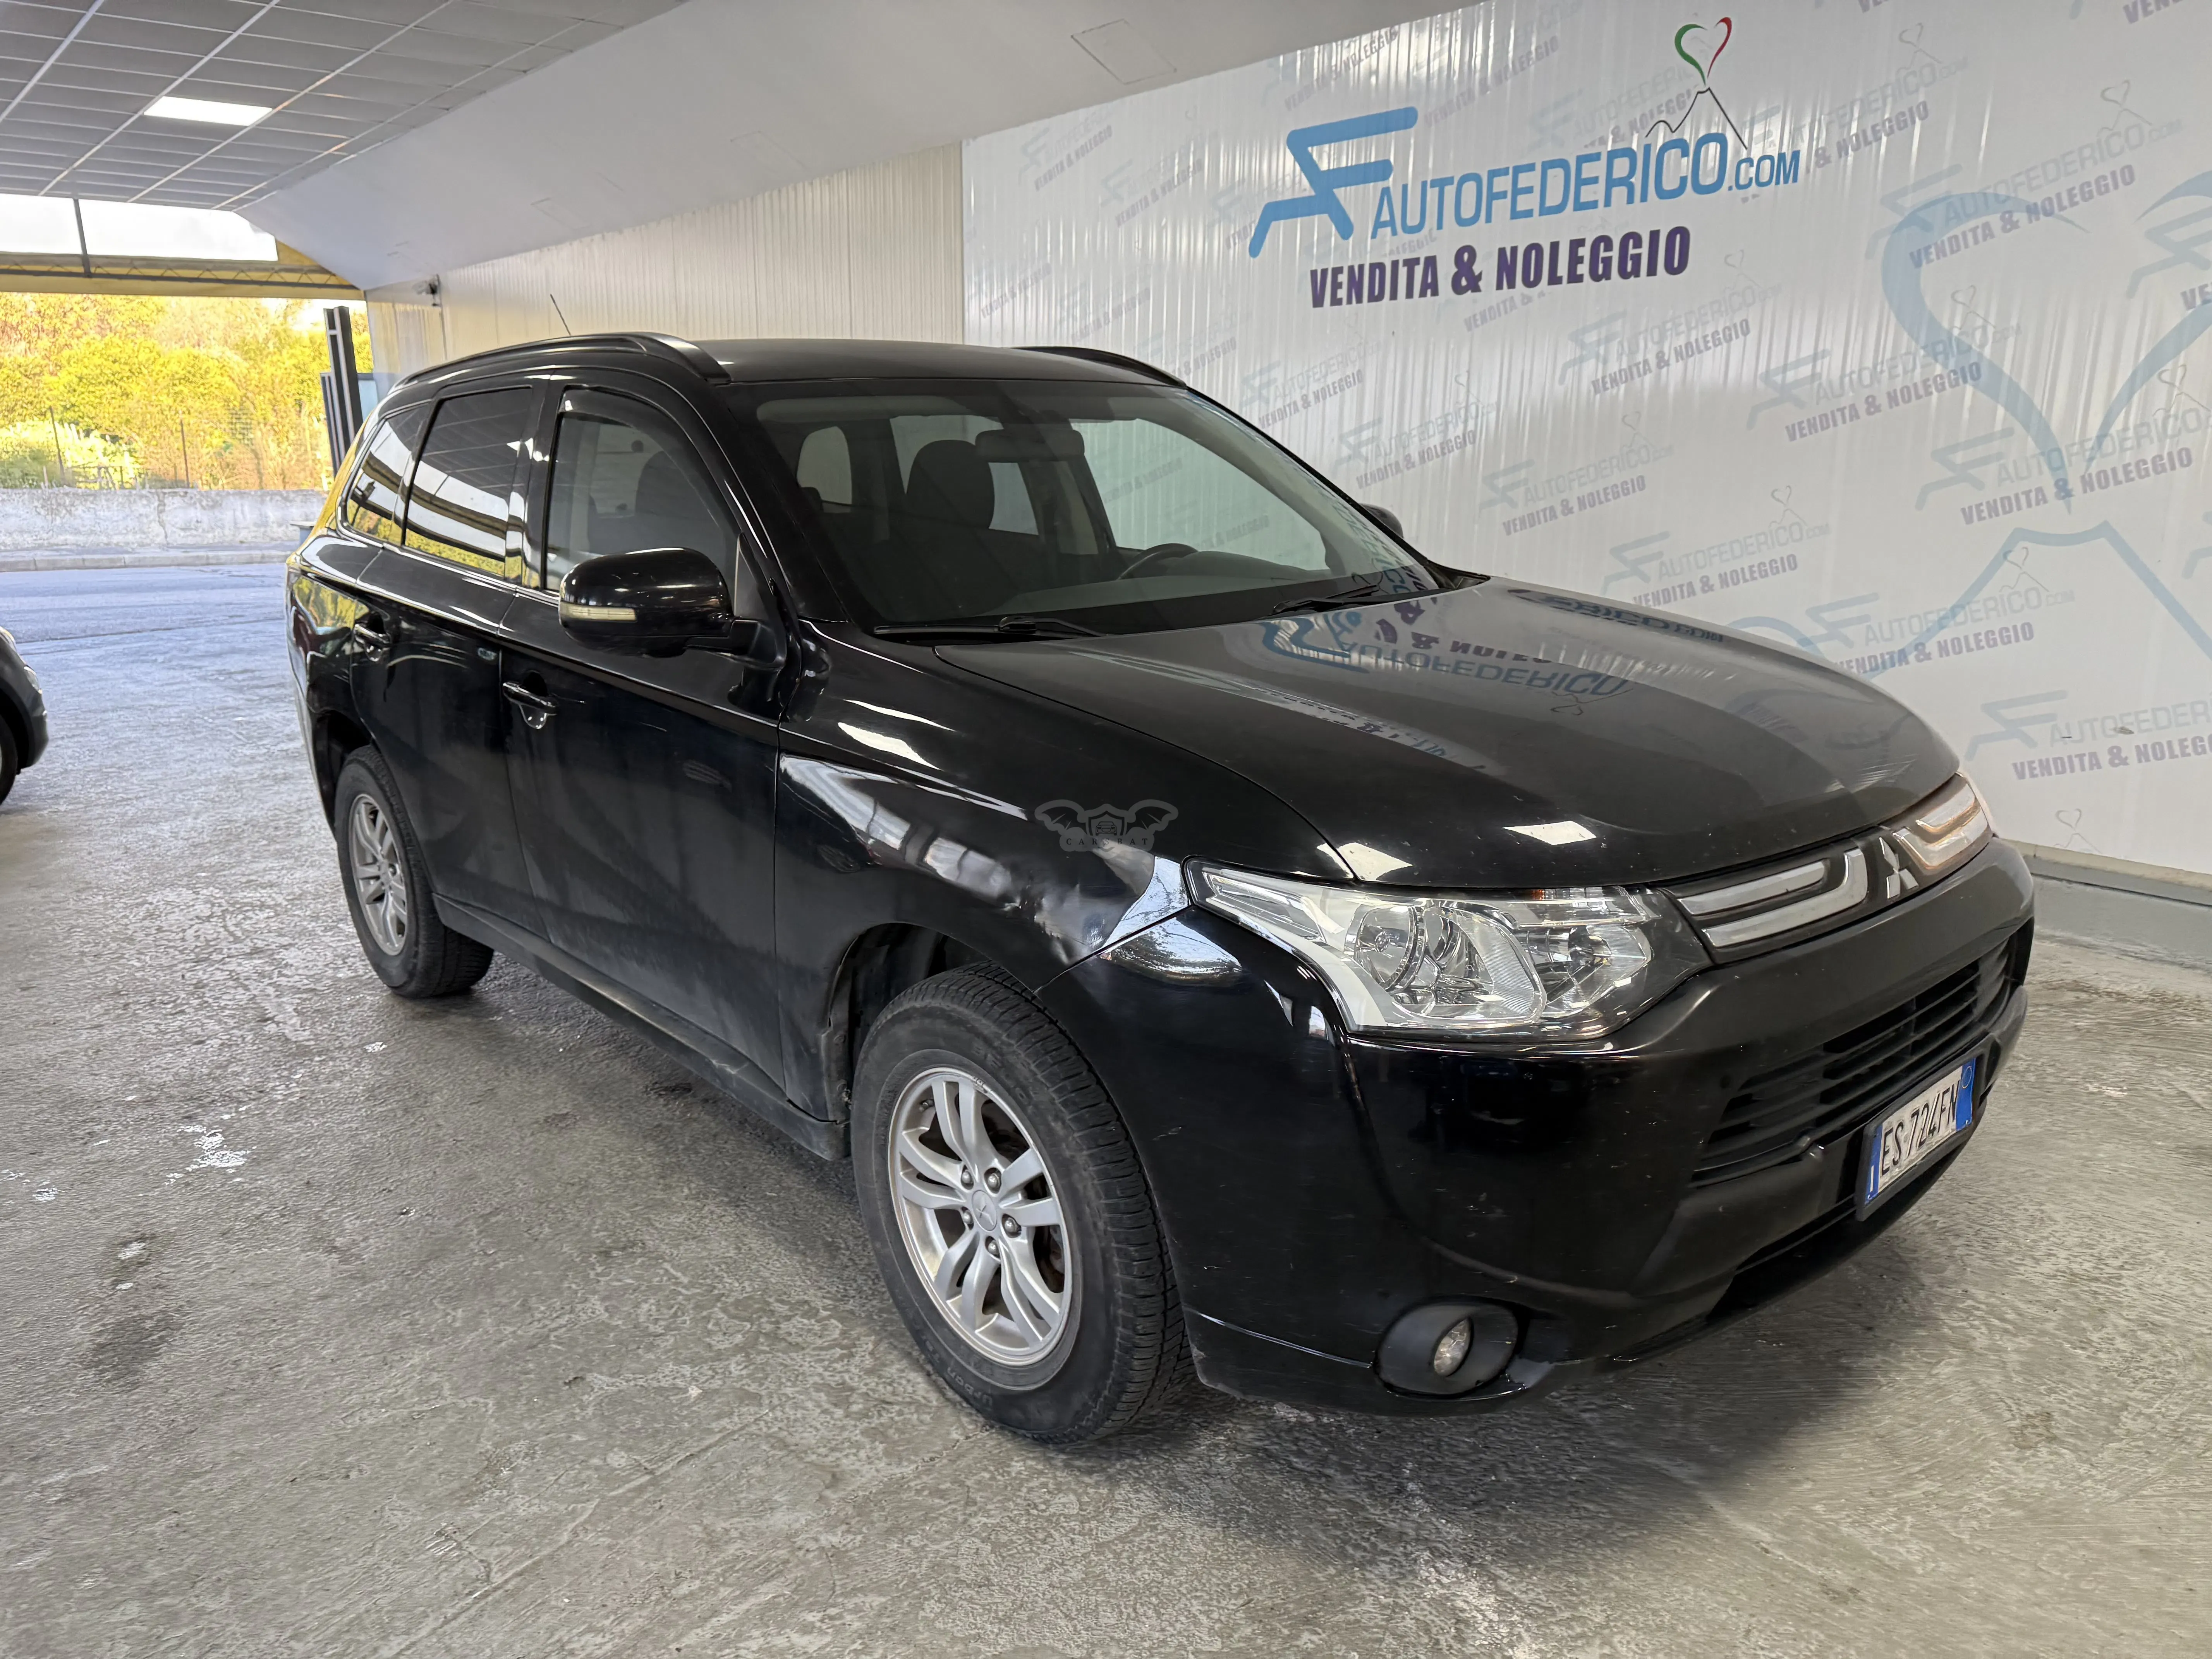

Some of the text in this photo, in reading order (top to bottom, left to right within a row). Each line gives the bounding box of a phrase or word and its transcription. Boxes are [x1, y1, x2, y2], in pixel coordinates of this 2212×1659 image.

[1814, 101, 1930, 168] & NOLEGGIO
[1370, 132, 1800, 239] AUTOFEDERICO.COM
[1909, 164, 2136, 270] VENDITA & NOLEGGIO
[1310, 226, 1691, 309] VENDITA & NOLEGGIO
[1591, 318, 1751, 395] VENDITA & NOLEGGIO
[1784, 361, 1982, 442] VENDITA & NOLEGGIO
[1502, 475, 1646, 536] VENDITA & NOLEGGIO
[1960, 447, 2193, 525] VENDITA & NOLEGGIO
[1699, 575, 1715, 594] &
[1717, 553, 1798, 589] NOLEGGIO
[1913, 642, 1933, 663] &
[1937, 622, 2035, 658] NOLEGGIO
[2012, 733, 2212, 780] VENDITA & NOLEG
[2049, 697, 2212, 747] AUTOFEDER
[1880, 1079, 1960, 1177] ES 724FN
